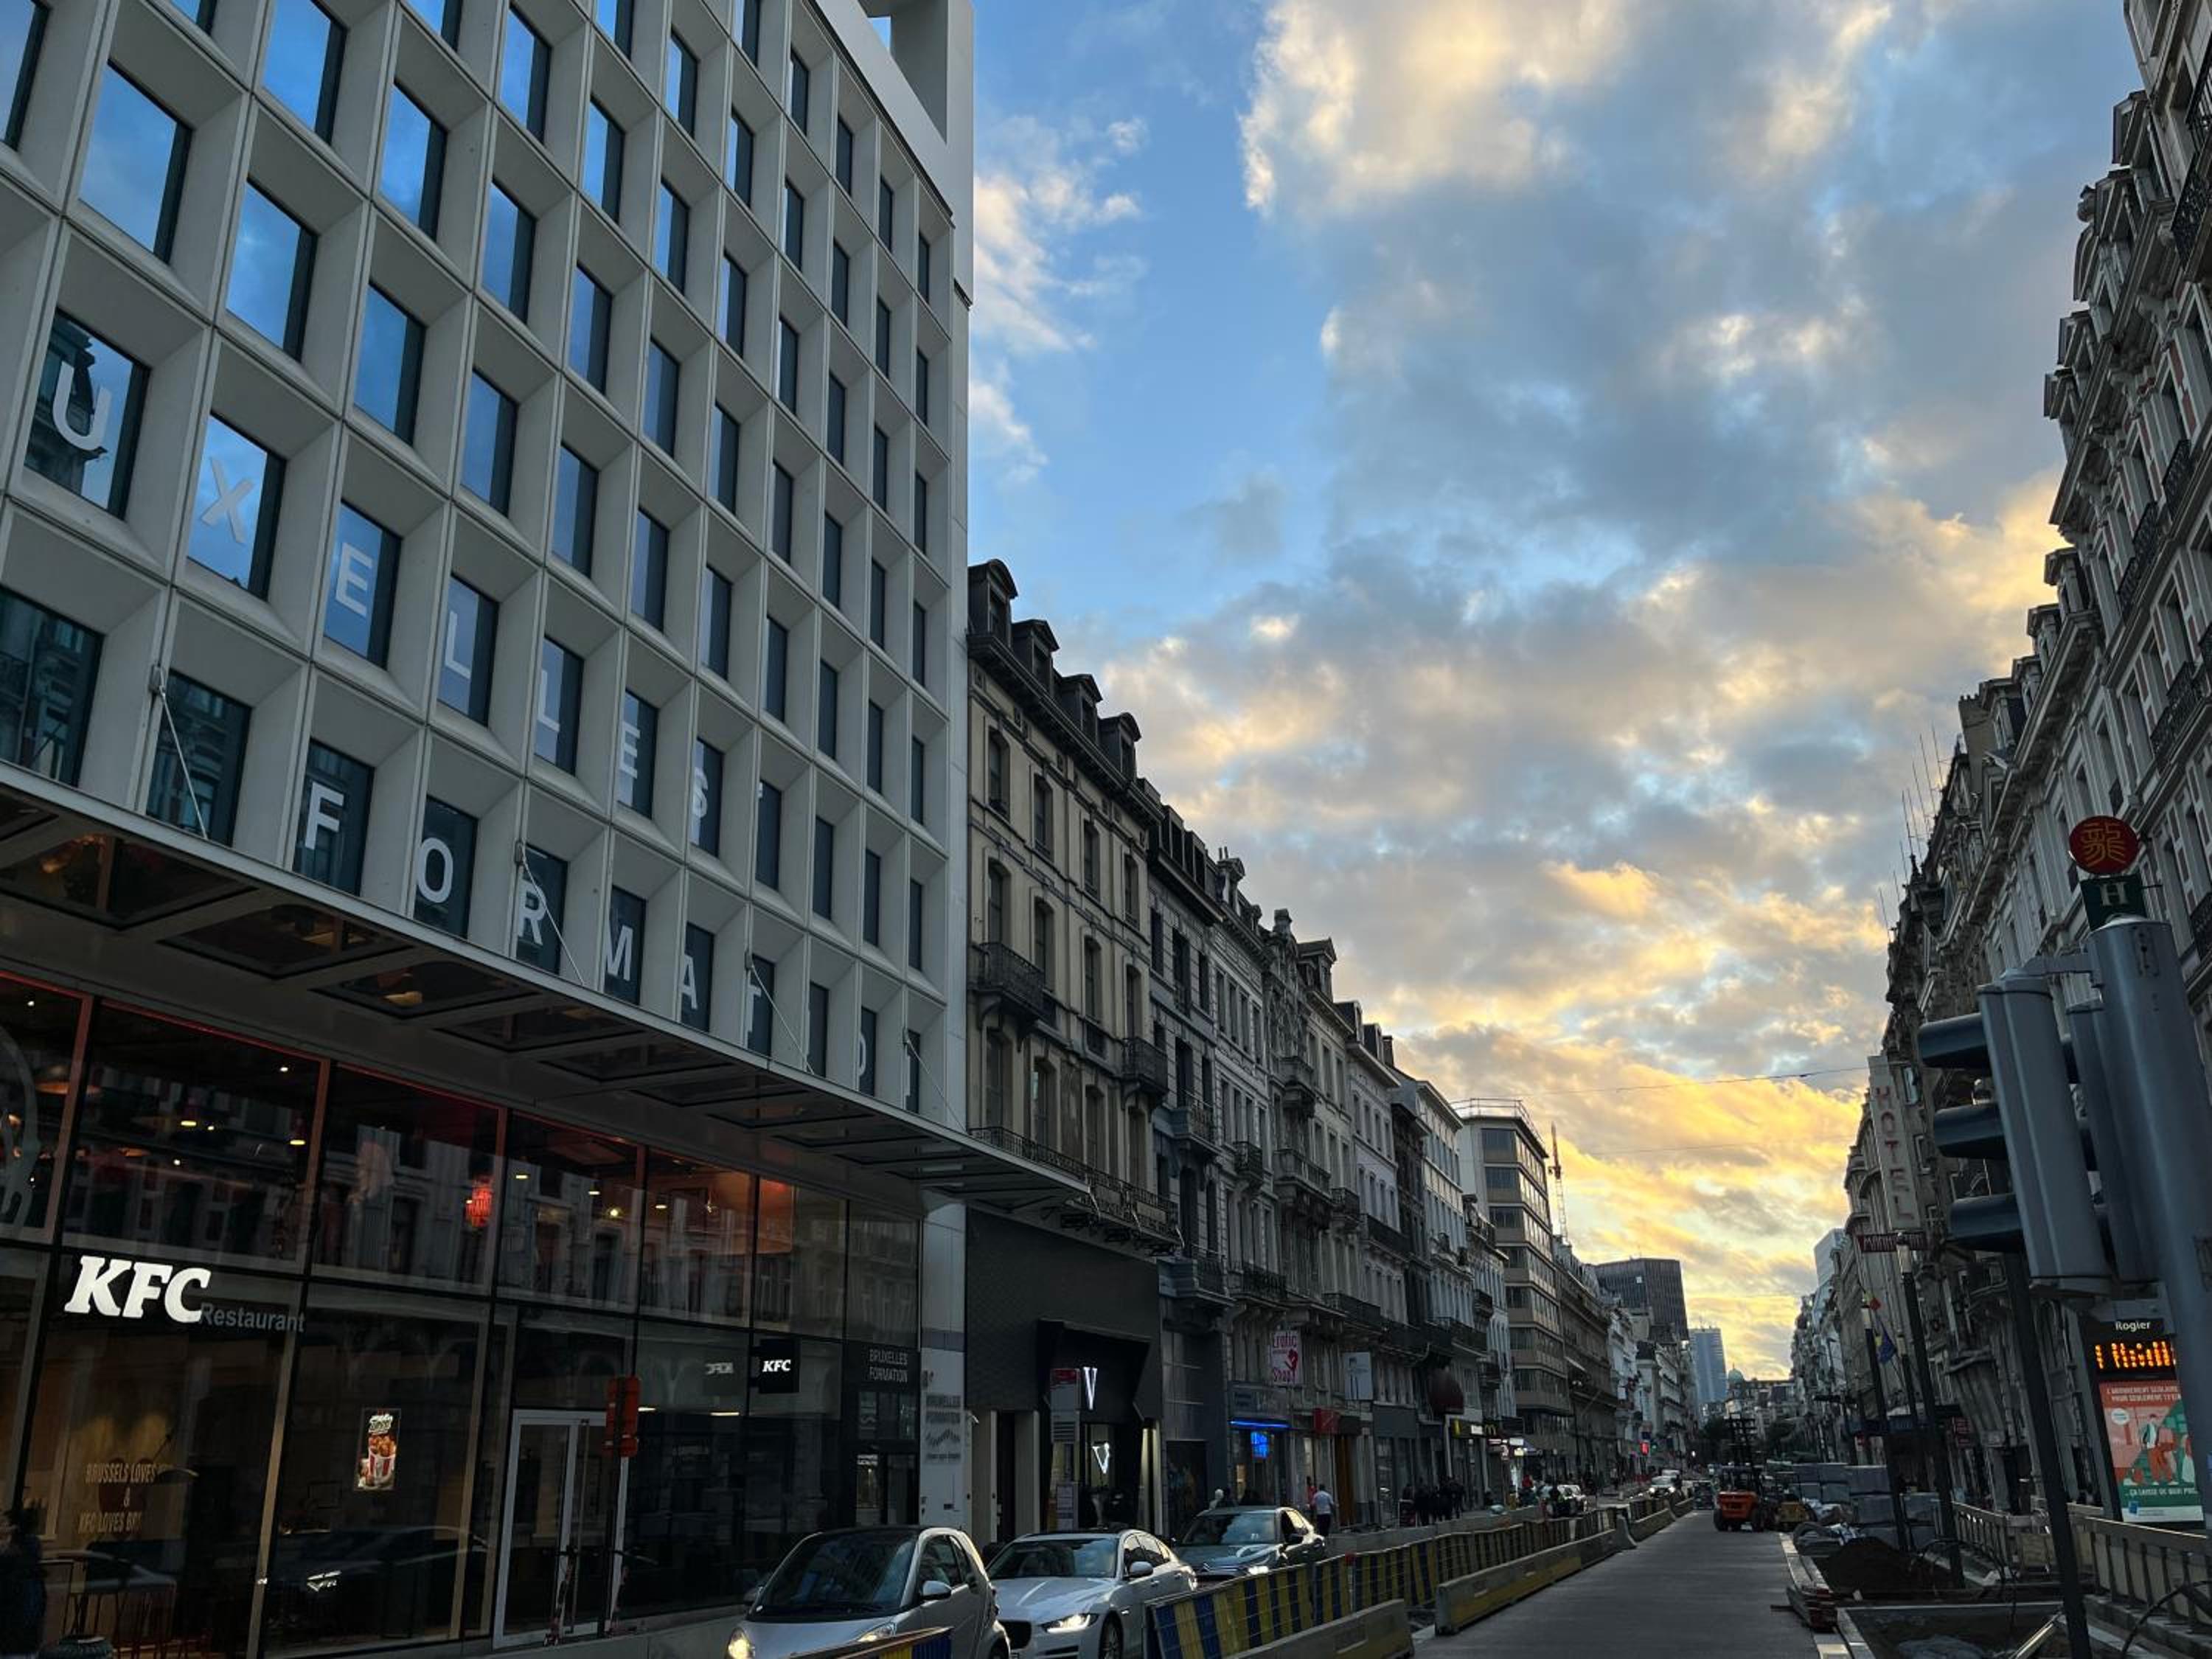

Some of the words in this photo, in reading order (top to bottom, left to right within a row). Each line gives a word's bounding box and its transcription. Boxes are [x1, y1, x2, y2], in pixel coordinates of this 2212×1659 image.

[2099, 881, 2129, 906] H
[1875, 1085, 1916, 1220] HOTEL
[64, 1255, 212, 1324] KFC
[200, 1302, 305, 1332] Restaurant
[2115, 1321, 2151, 1332] Rogier
[762, 1359, 791, 1373] KFC
[869, 1348, 908, 1366] BRUXELLES
[869, 1366, 908, 1384] FORMATION
[85, 1463, 130, 1484] BRUSSELS
[130, 1463, 156, 1483] LOVES
[97, 1512, 125, 1534] LOVES
